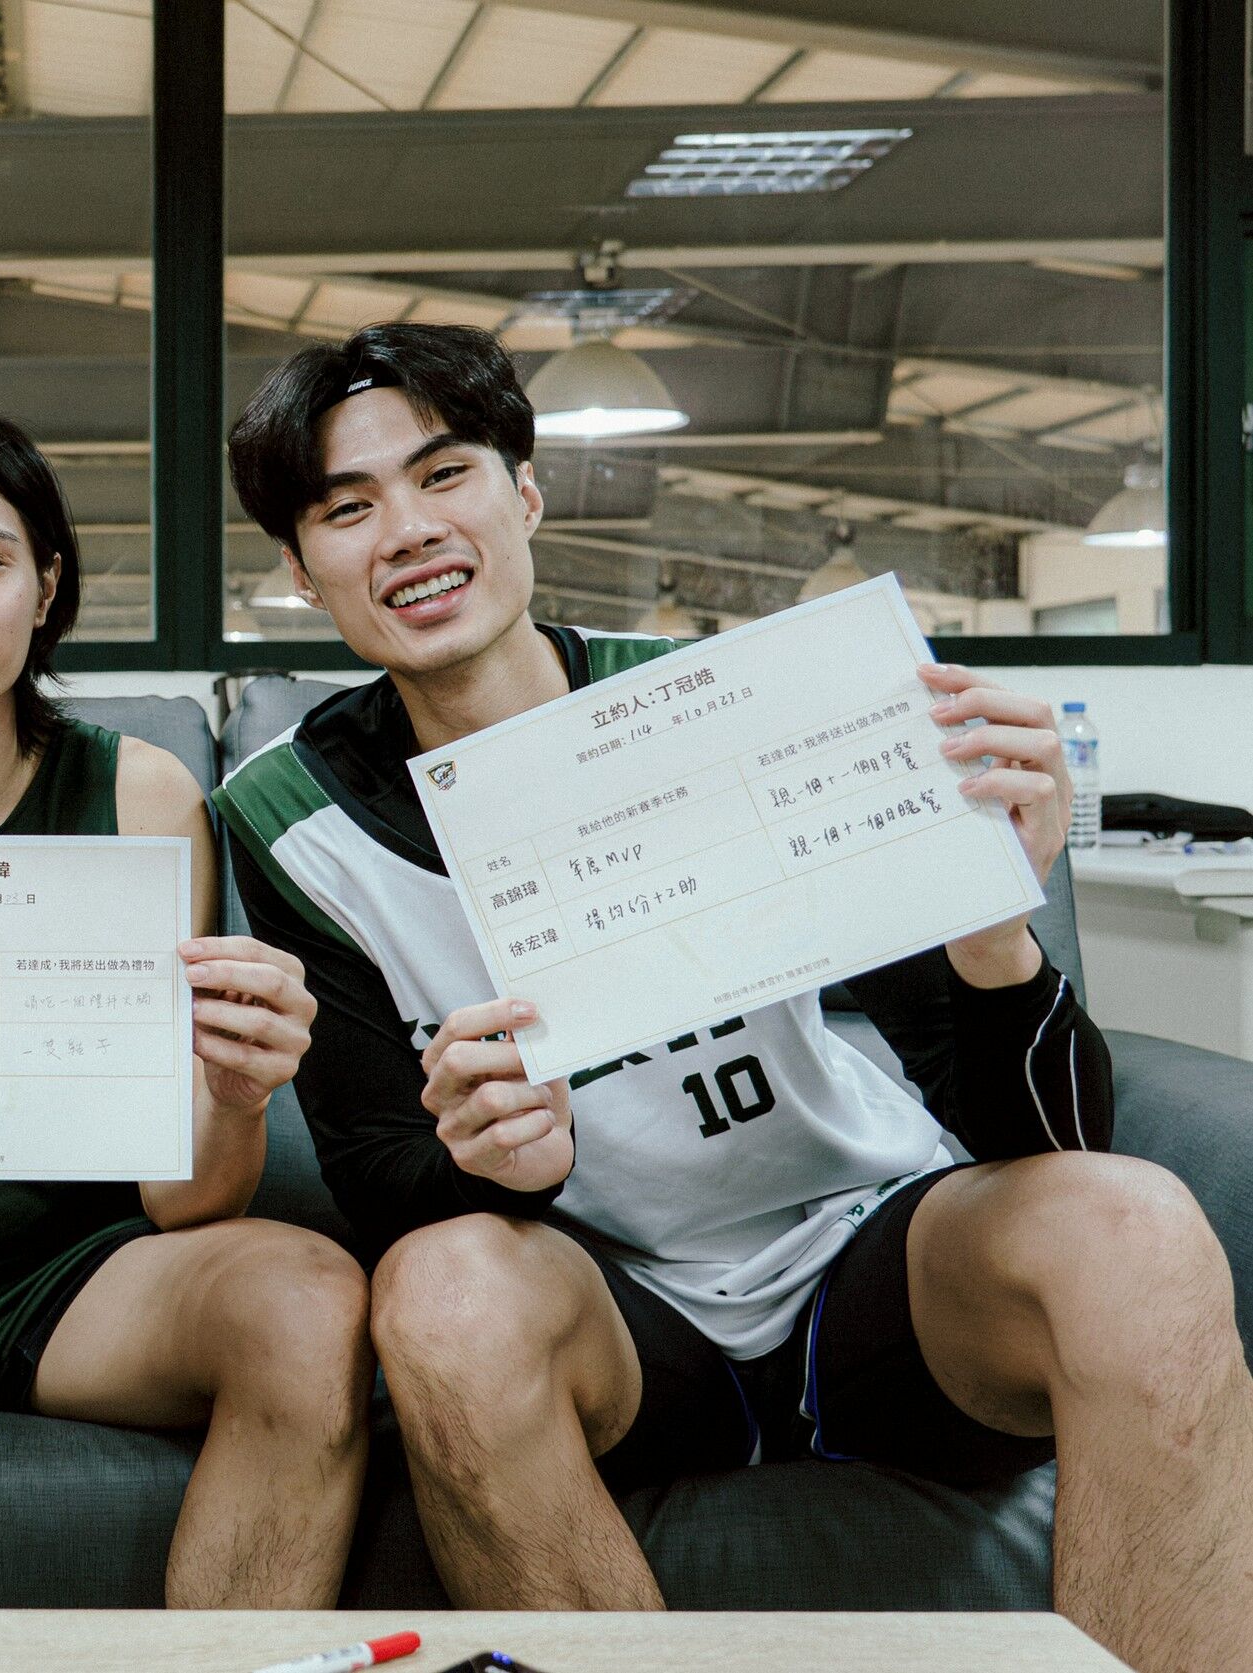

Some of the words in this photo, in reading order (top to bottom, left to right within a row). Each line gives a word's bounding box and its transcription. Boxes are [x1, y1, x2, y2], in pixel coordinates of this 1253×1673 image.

[347, 378, 373, 393] NIKE
[591, 668, 716, 729] 立約人：丁冠皓
[630, 725, 652, 741] 114
[671, 714, 684, 726] 年
[685, 708, 702, 721] 10
[706, 701, 718, 713] 月
[741, 687, 753, 700] 日
[577, 786, 688, 837] 我給他的新賽季任務
[487, 856, 511, 872] 姓名
[490, 880, 540, 910] 高錦瑋
[509, 928, 560, 958] 徐宏瑋
[682, 1054, 776, 1139] 10
